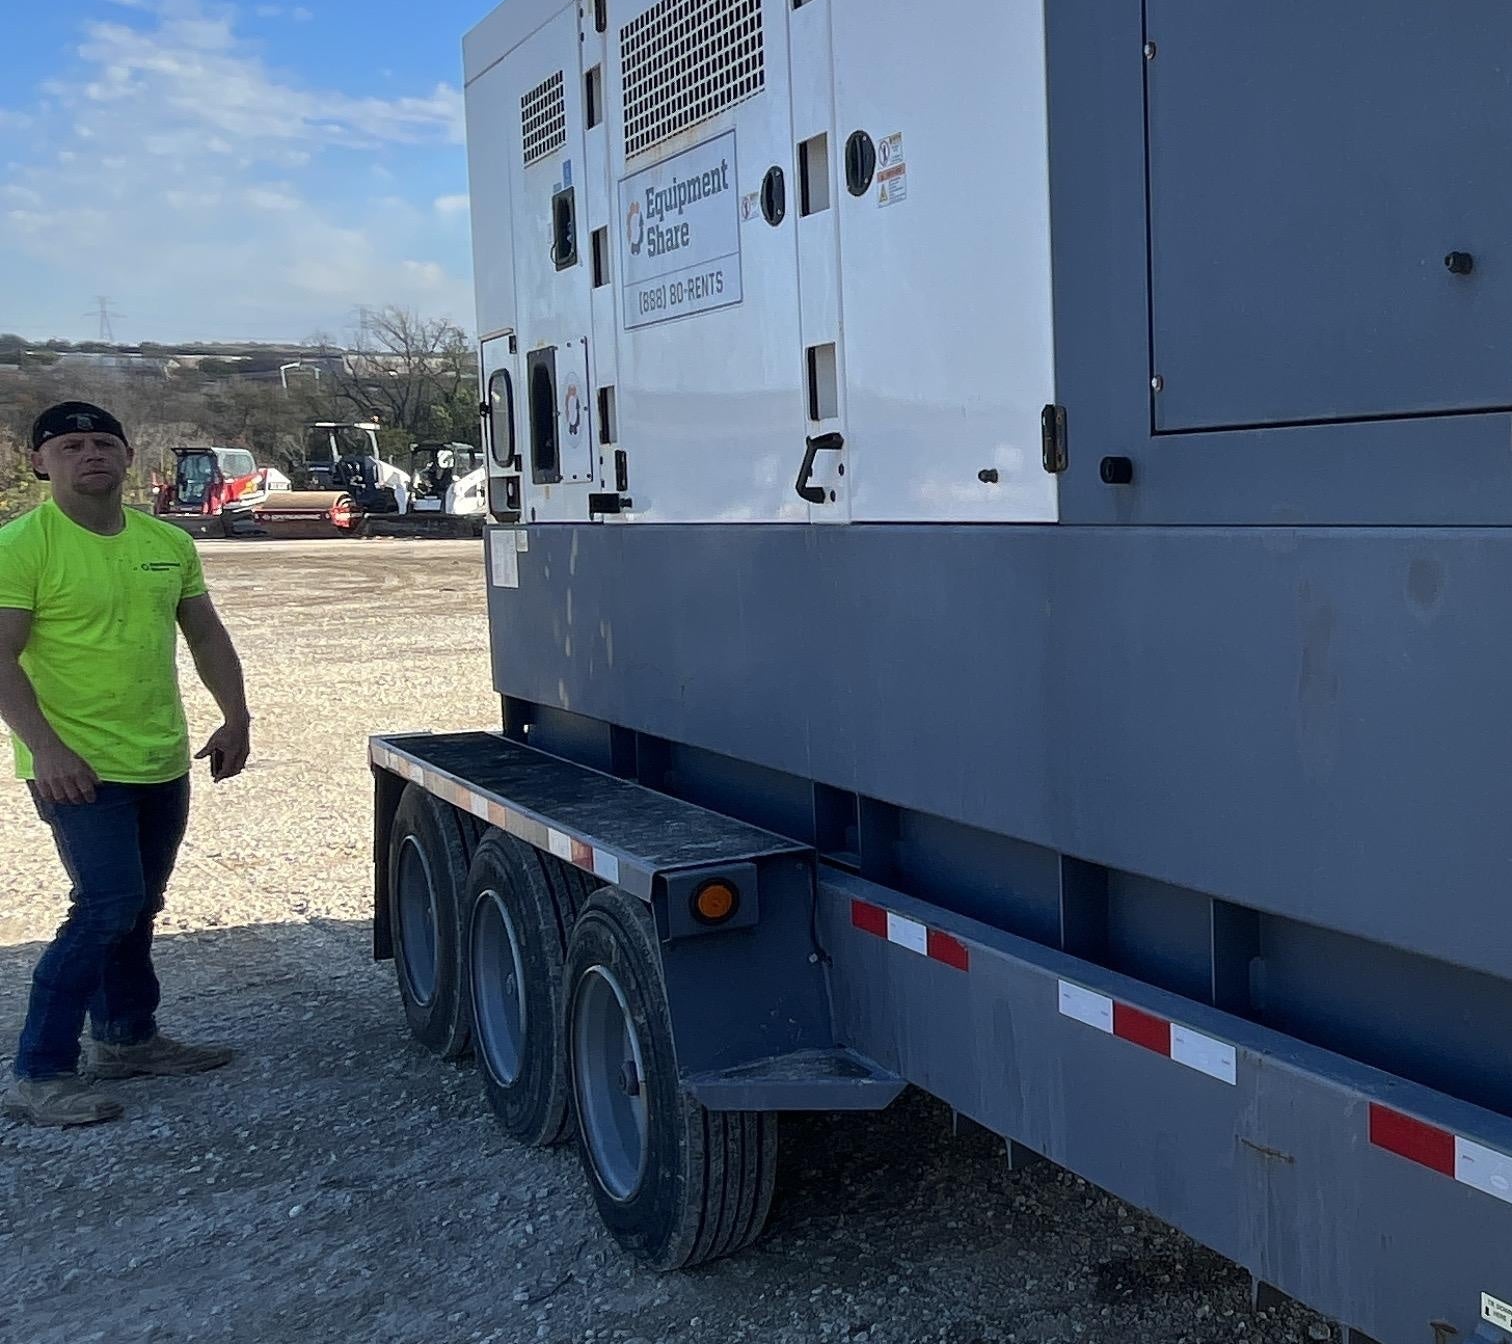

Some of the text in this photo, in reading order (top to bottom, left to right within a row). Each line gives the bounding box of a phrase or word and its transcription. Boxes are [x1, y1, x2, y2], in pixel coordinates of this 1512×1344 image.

[645, 158, 729, 222] Equipment
[647, 221, 690, 258] Share
[638, 270, 724, 316] (888) 80-RENTS
